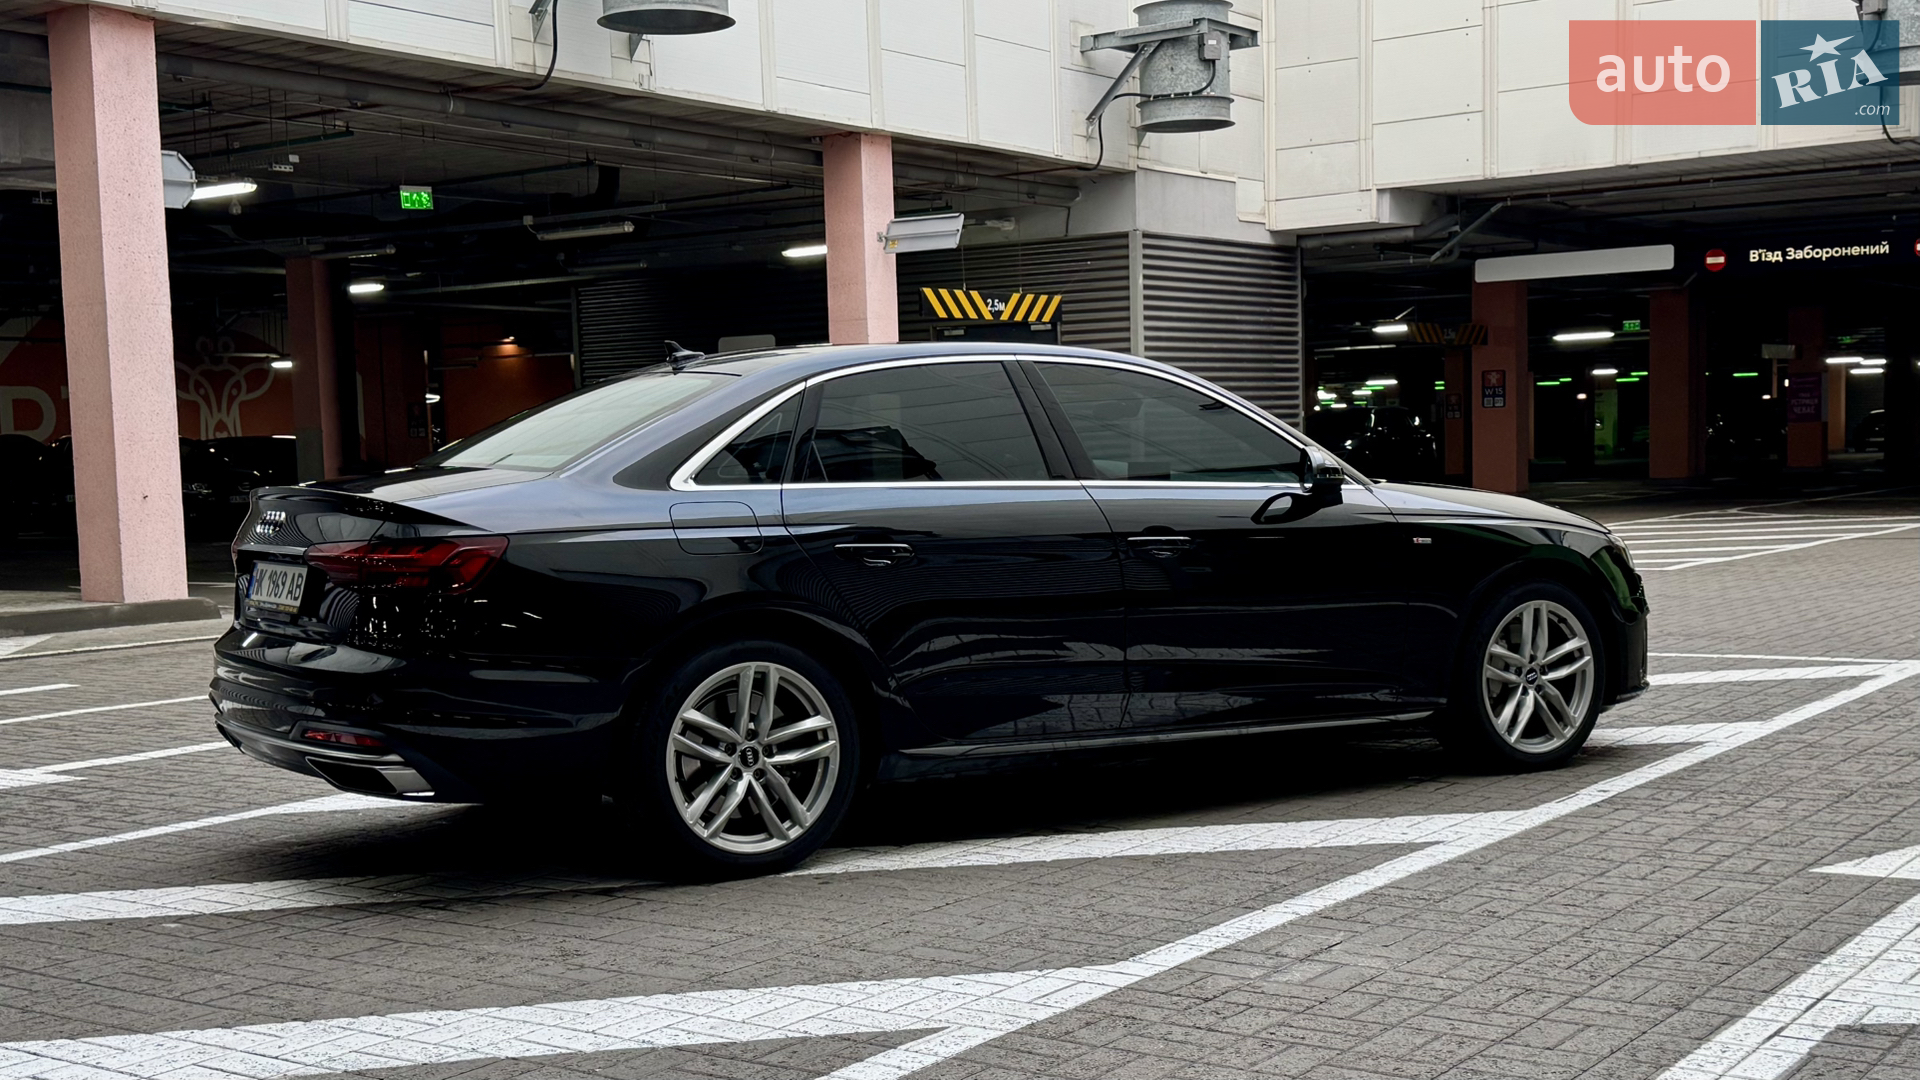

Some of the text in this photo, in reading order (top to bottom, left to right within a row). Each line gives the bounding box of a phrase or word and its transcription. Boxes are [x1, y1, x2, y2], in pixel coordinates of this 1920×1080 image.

[1785, 241, 1890, 261] Заборонений
[266, 569, 288, 599] 1969
[285, 572, 304, 601] AB
